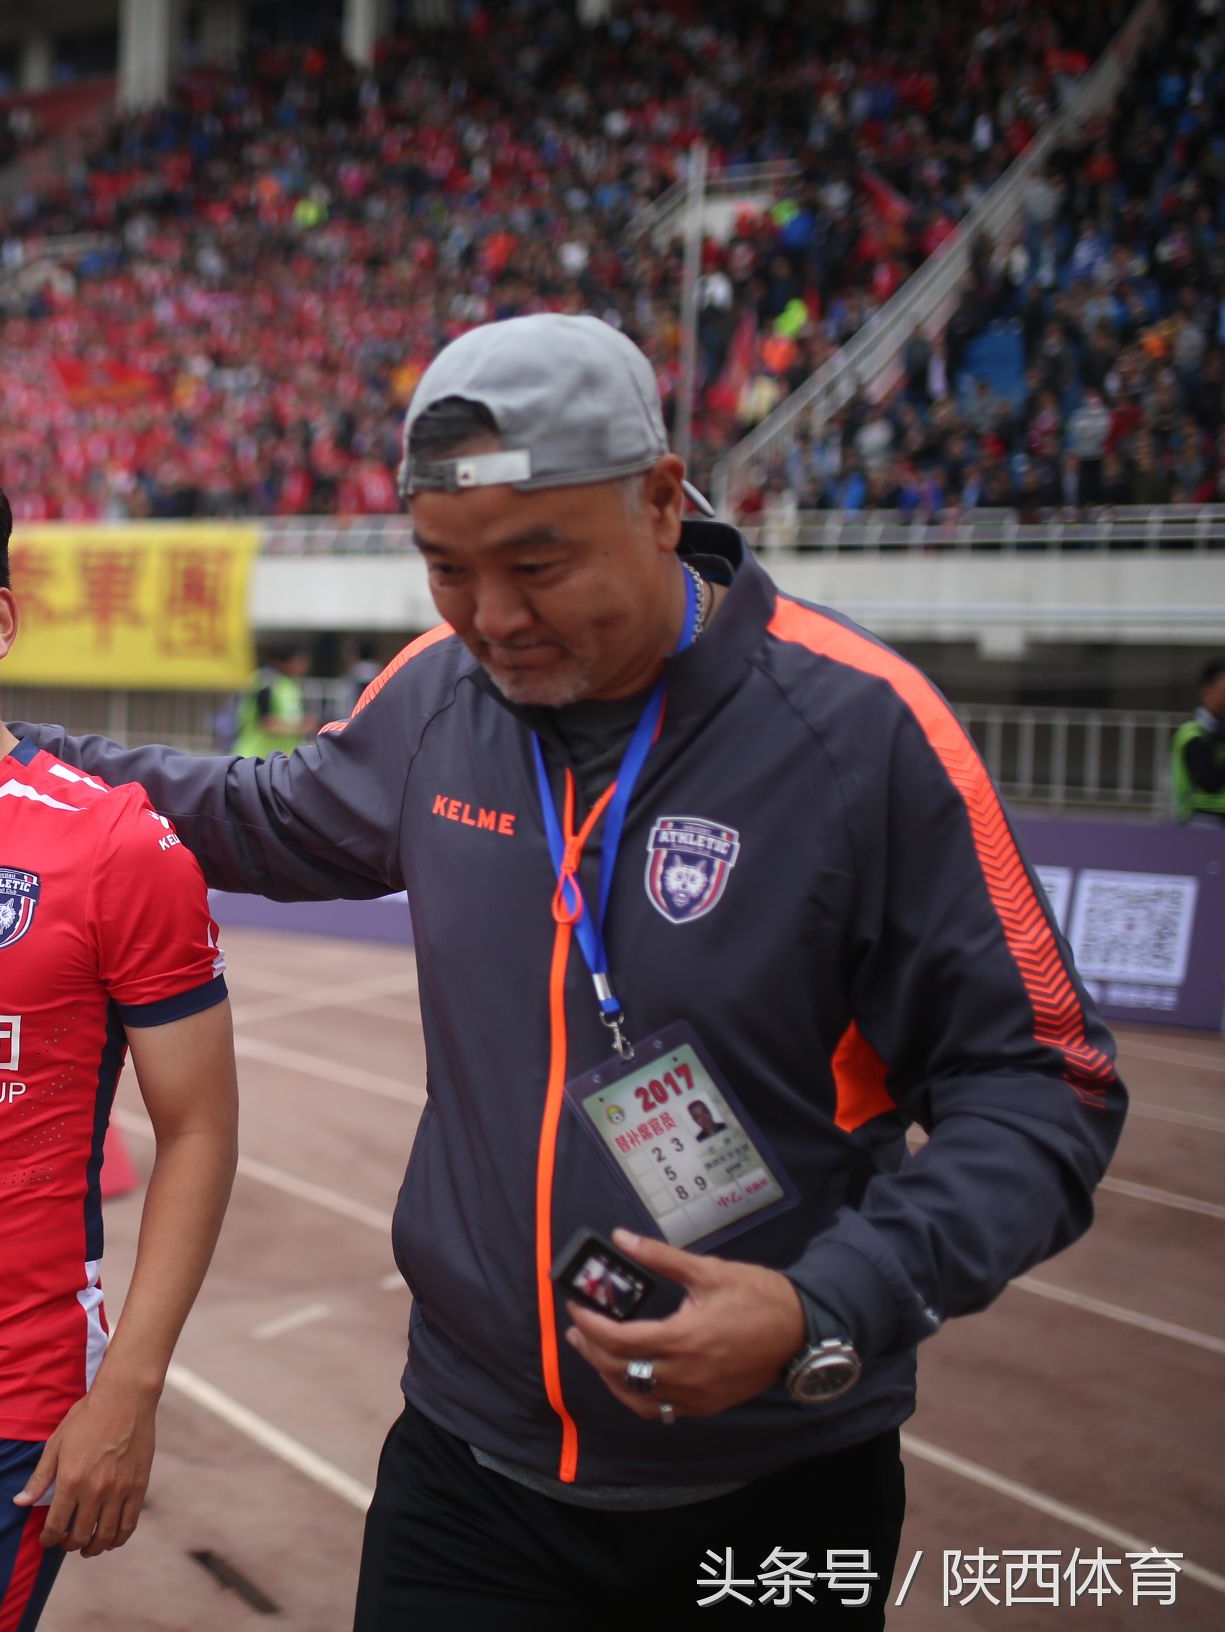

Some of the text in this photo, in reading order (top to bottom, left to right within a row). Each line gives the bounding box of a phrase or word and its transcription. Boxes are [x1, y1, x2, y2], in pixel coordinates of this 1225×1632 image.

[432, 794, 517, 837] KELME
[634, 1063, 695, 1113] 2017
[614, 1111, 678, 1154] 替补席官员
[652, 1137, 685, 1163] 2 3
[664, 1166, 677, 1182] 5
[676, 1176, 708, 1201] 8 9
